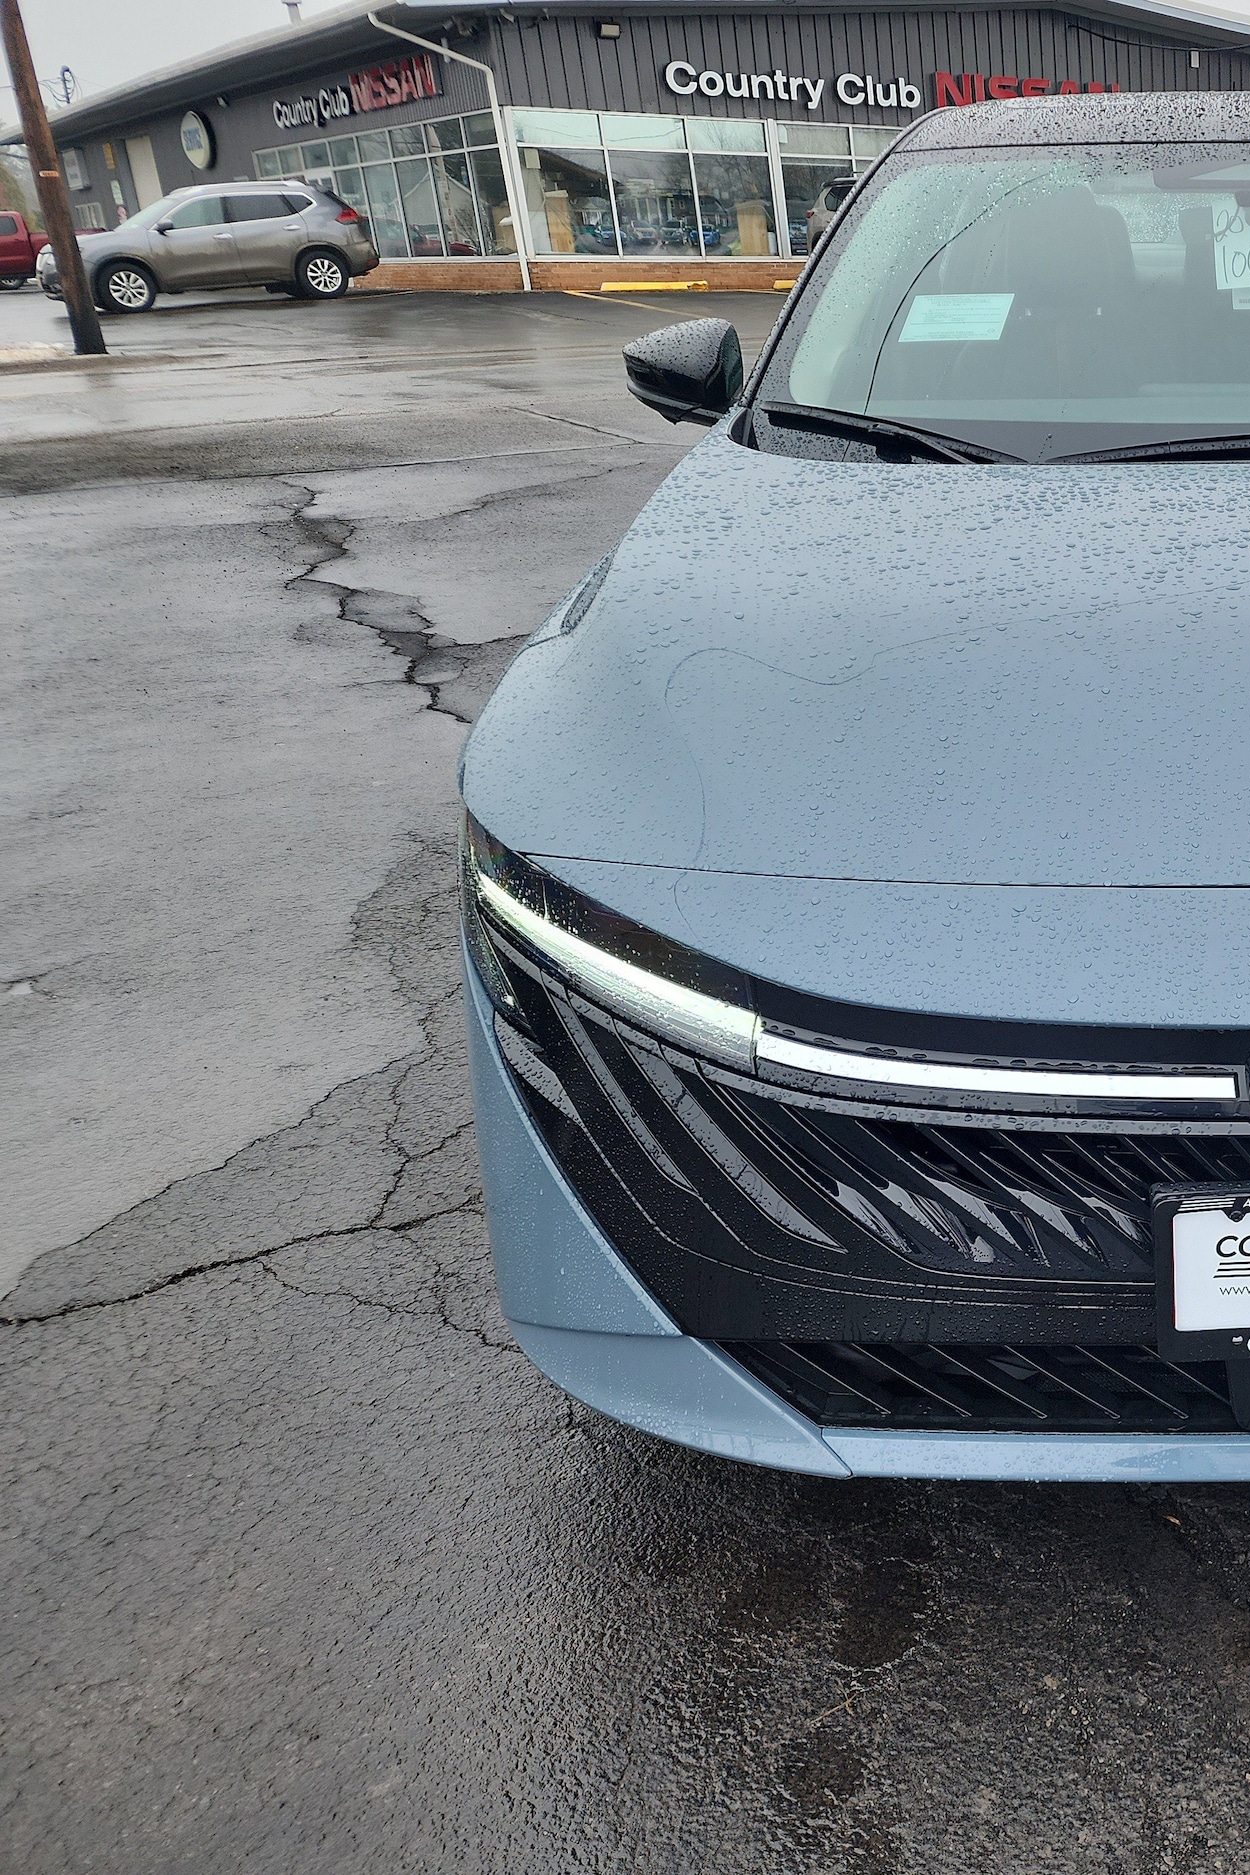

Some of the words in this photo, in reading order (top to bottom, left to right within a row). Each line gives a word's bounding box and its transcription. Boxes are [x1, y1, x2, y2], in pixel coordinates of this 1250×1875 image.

[273, 95, 318, 129] Country
[318, 86, 350, 120] Club
[348, 53, 437, 114] NISSAN
[665, 60, 825, 110] Country
[836, 72, 921, 109] Club
[934, 71, 1121, 108] NISS
